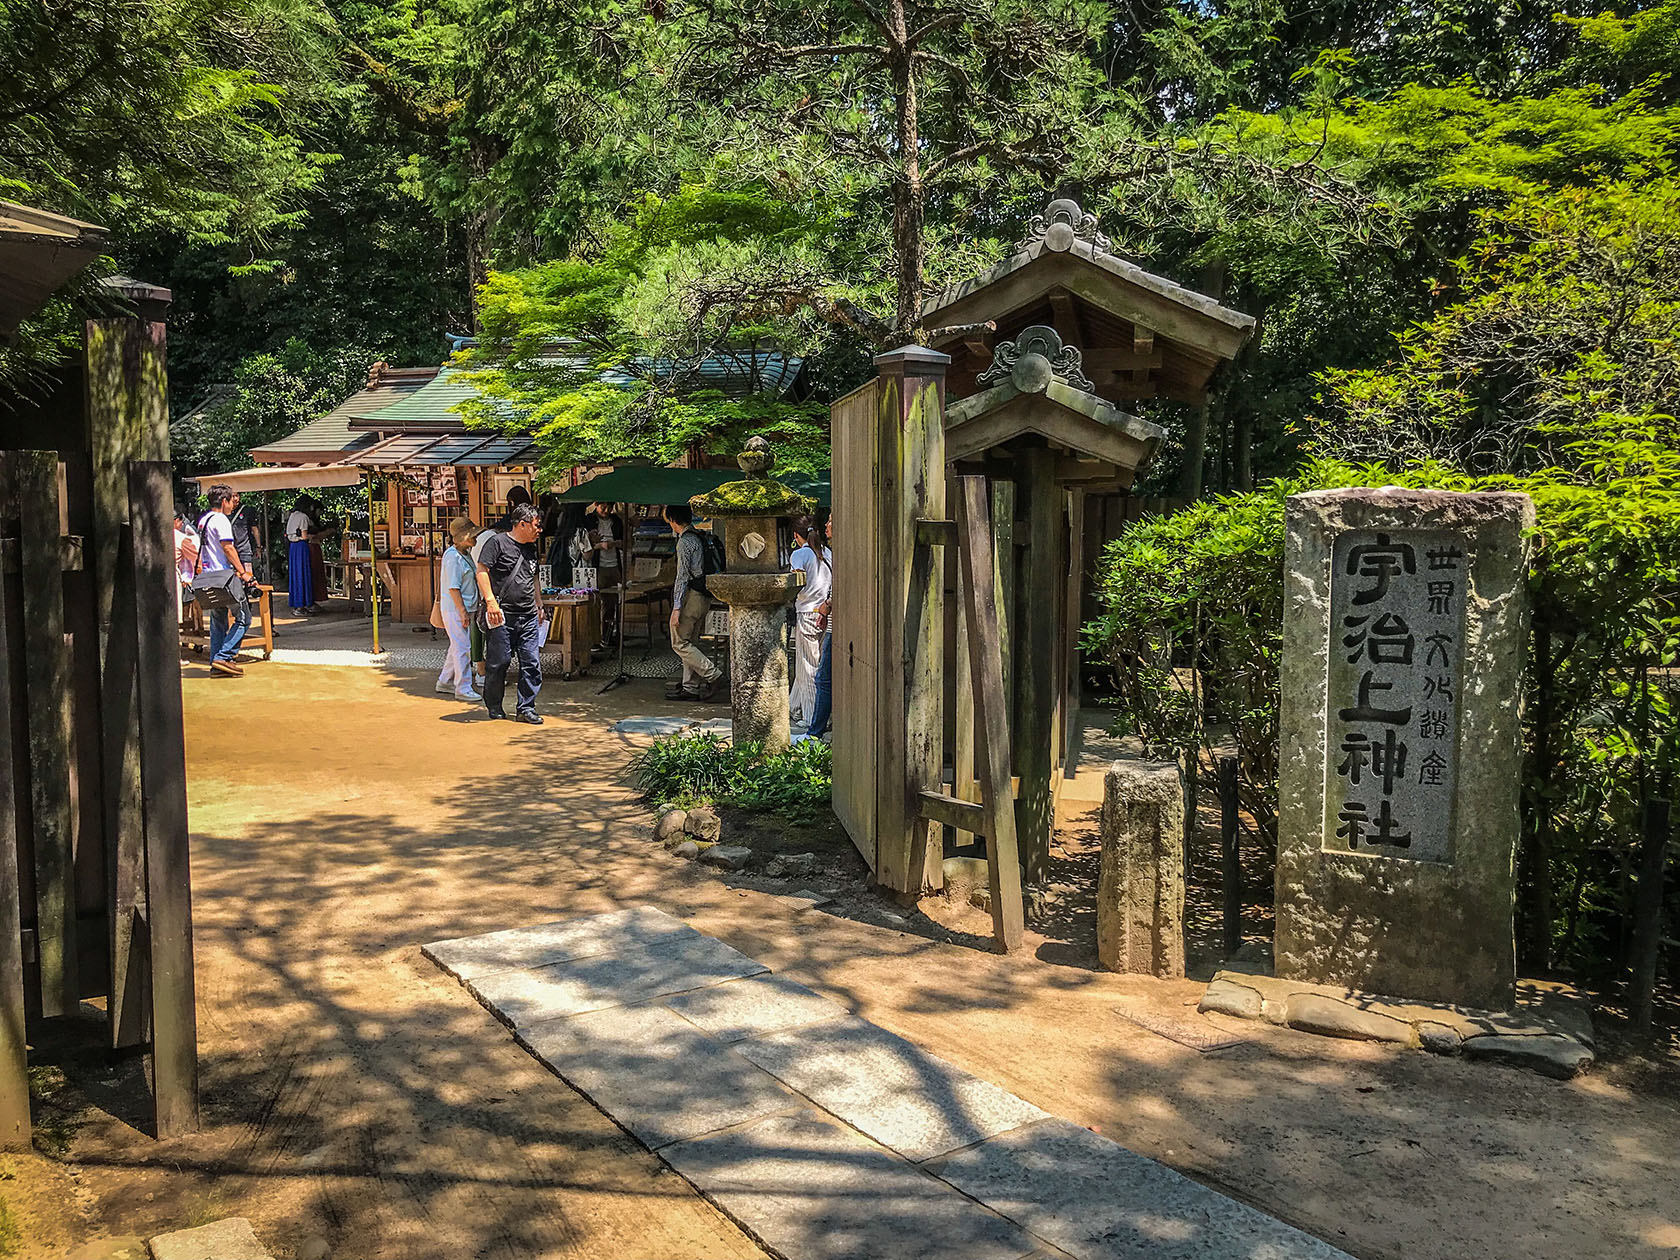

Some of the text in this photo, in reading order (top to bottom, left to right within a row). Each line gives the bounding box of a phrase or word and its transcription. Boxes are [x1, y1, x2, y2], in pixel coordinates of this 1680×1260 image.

[1335, 532, 1417, 850] 宇治上神社
[1418, 545, 1462, 786] 世界文化遺産
